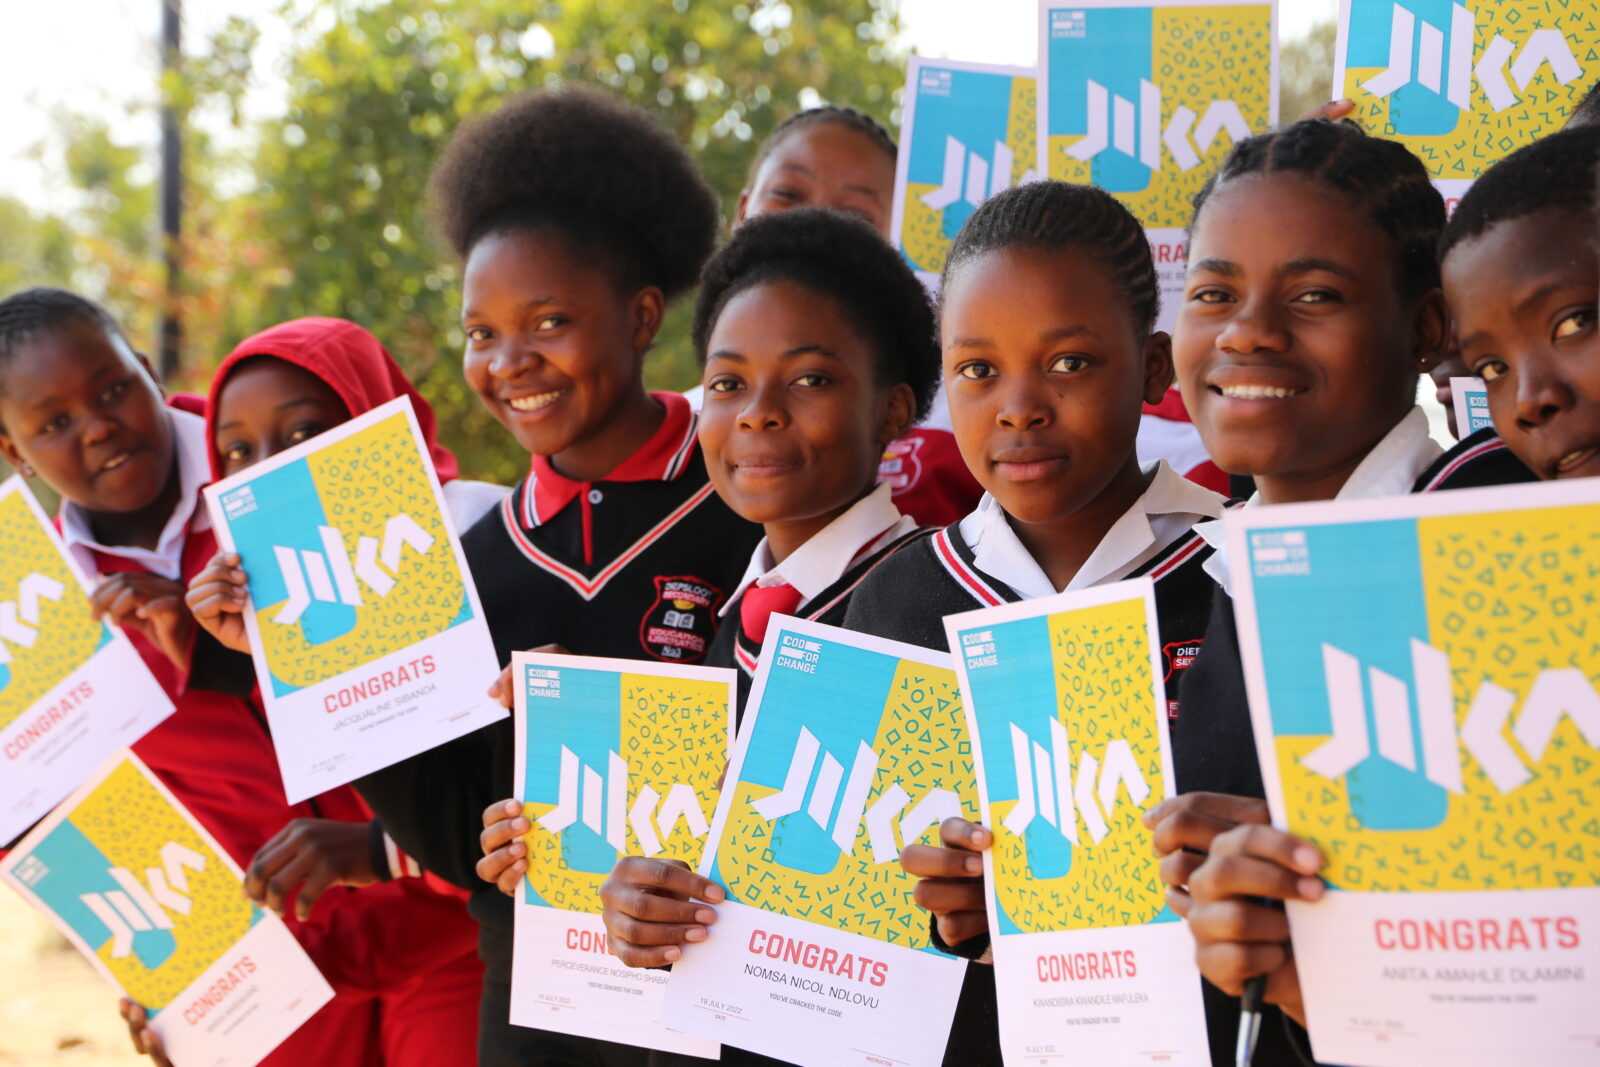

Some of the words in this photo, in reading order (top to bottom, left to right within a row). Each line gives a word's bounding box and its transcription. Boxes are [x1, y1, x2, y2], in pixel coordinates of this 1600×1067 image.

[323, 655, 437, 714] CONGRATS
[777, 656, 817, 674] CHANGE
[4, 681, 94, 760] CONGRATS
[1374, 917, 1581, 951] CONGRATS
[748, 929, 889, 987] CONGRATS
[1037, 950, 1137, 982] CONGRATS
[184, 956, 257, 1024] CONGRATS
[744, 963, 787, 984] NOMSA
[790, 976, 825, 995] NICOL
[829, 986, 880, 1009] NDLOVU
[789, 998, 815, 1011] CRACKED
[816, 1003, 827, 1013] THE
